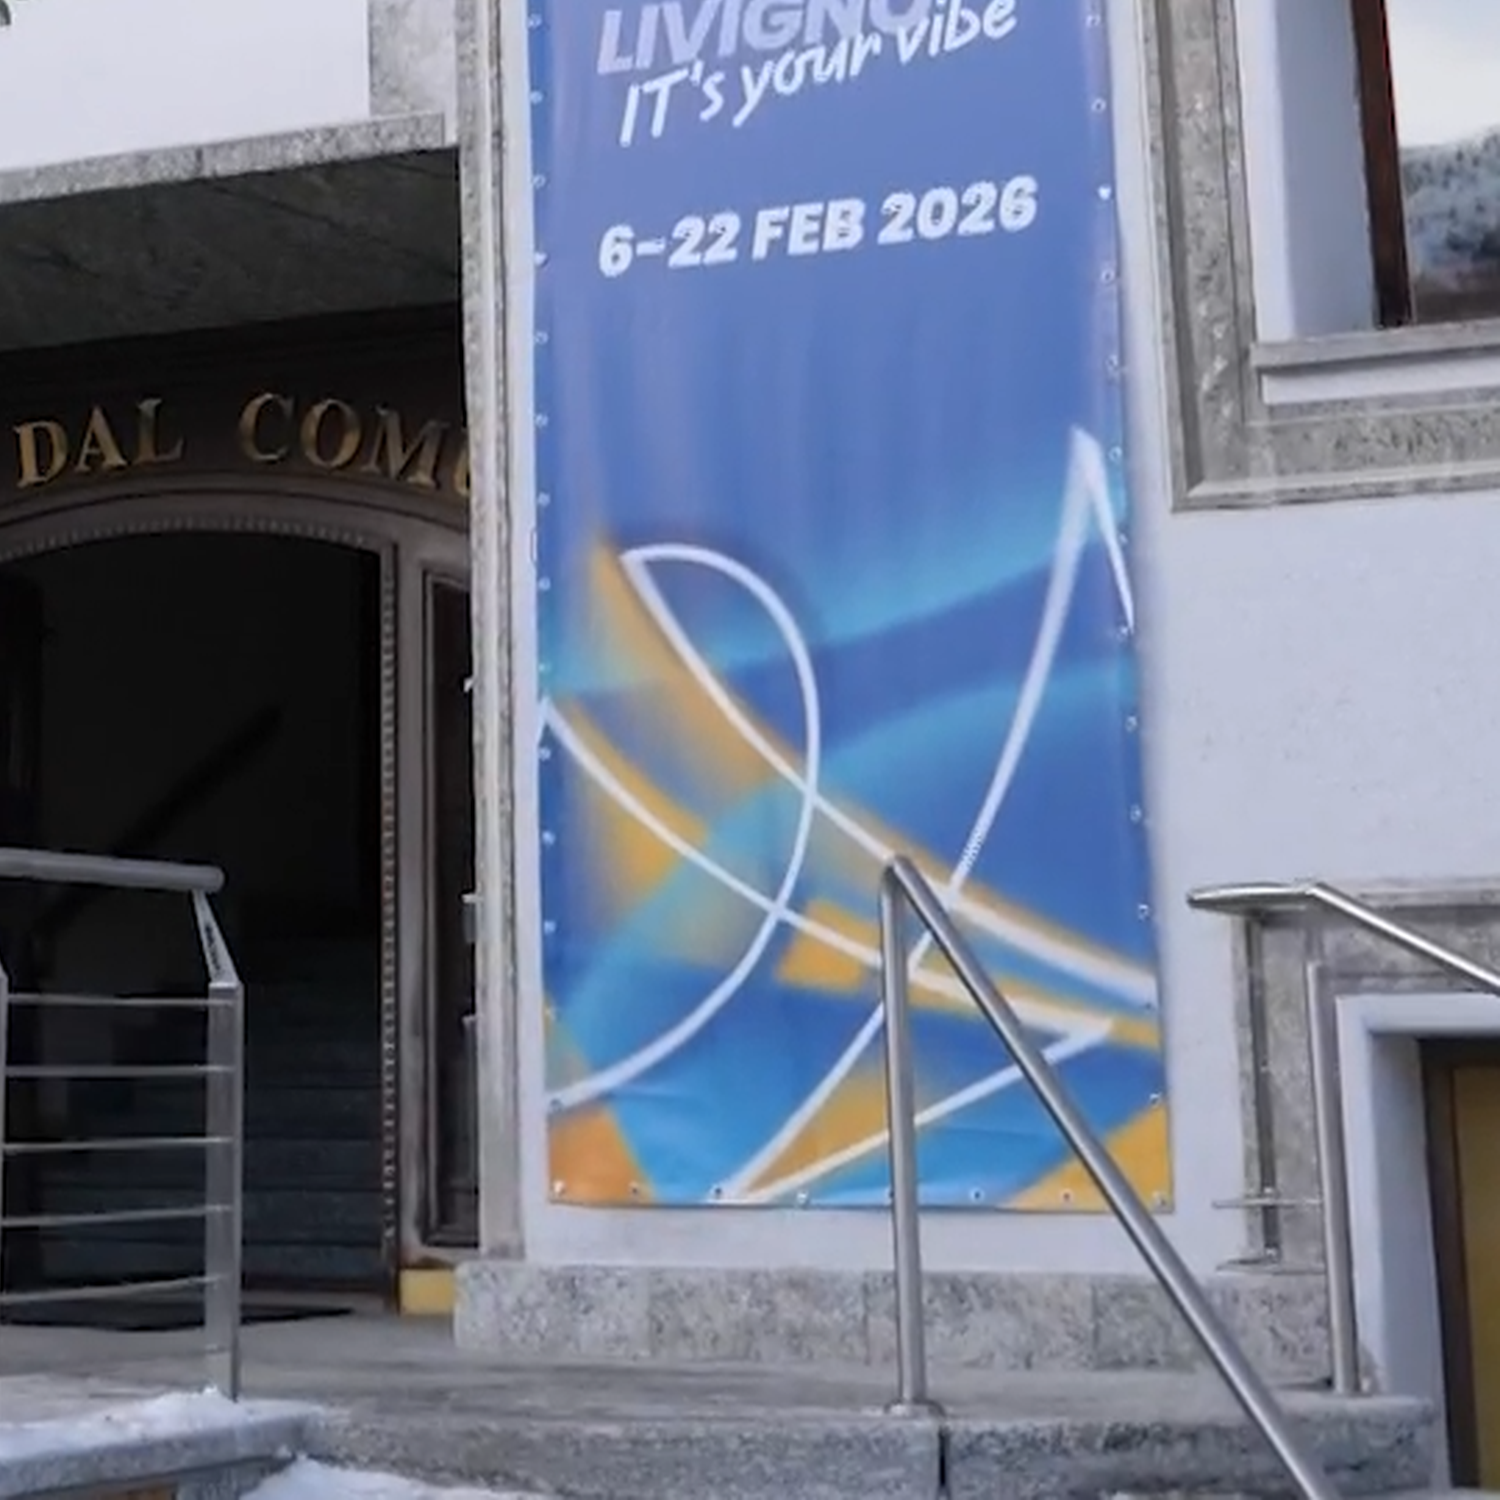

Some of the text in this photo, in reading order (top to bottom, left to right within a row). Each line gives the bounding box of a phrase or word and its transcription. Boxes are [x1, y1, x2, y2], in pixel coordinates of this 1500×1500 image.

[732, 30, 882, 128] your
[752, 197, 867, 260] FEB
[877, 174, 1039, 246] 2026
[13, 398, 184, 489] DAL
